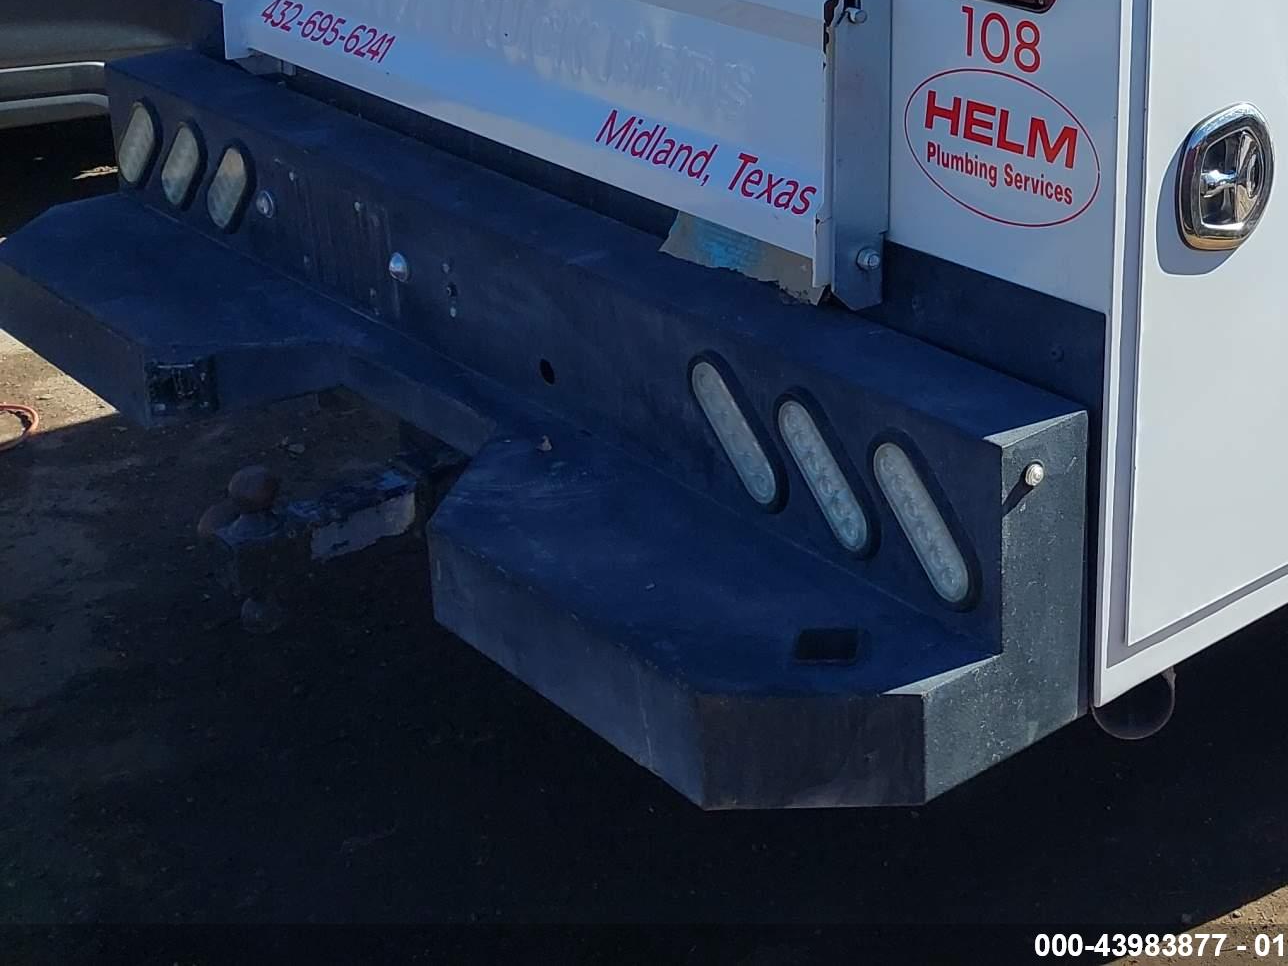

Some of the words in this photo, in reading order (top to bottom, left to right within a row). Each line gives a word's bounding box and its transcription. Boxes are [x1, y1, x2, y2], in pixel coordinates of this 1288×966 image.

[961, 5, 1041, 73] 108
[595, 108, 719, 187] Midland,
[727, 152, 817, 216] Texas
[924, 89, 1079, 170] HELM
[926, 140, 998, 188] Plumbing
[1003, 162, 1073, 206] Services
